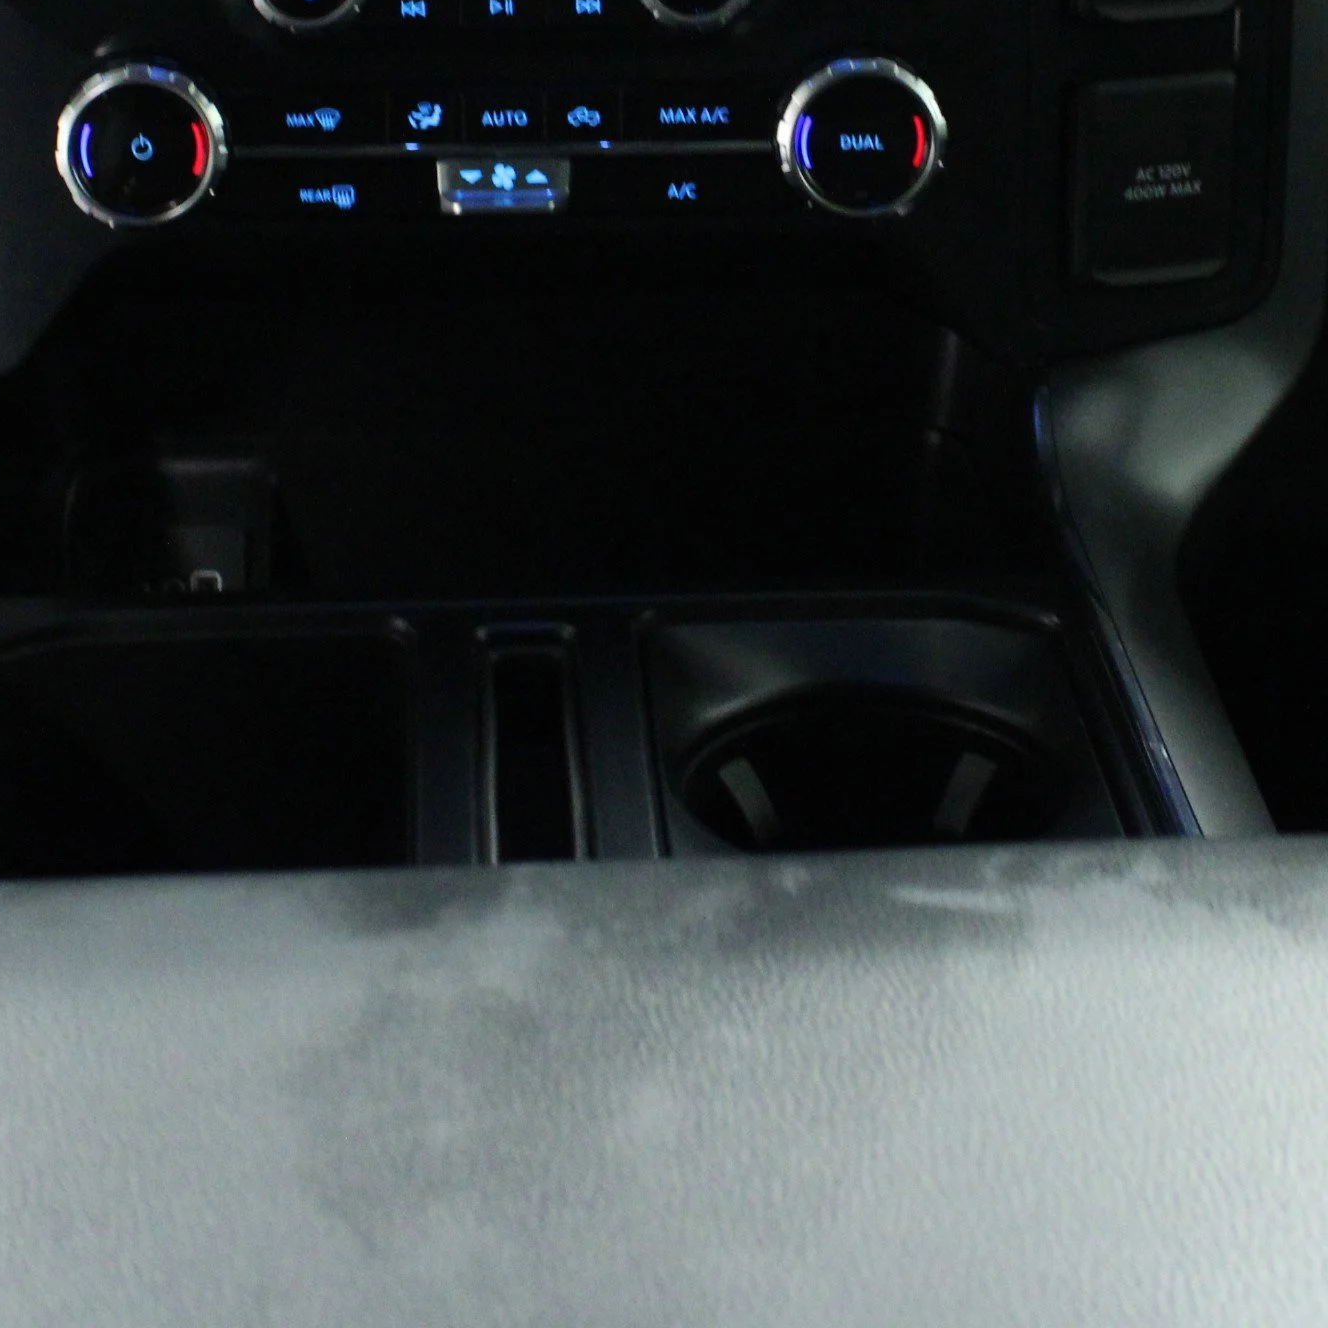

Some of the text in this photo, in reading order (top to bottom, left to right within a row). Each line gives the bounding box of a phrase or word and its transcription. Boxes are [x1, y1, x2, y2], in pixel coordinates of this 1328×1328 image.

[481, 110, 529, 128] AUTO
[660, 106, 730, 124] MAX A/C
[840, 134, 885, 152] DUAL
[299, 188, 332, 203] REAR
[667, 182, 697, 201] A/C
